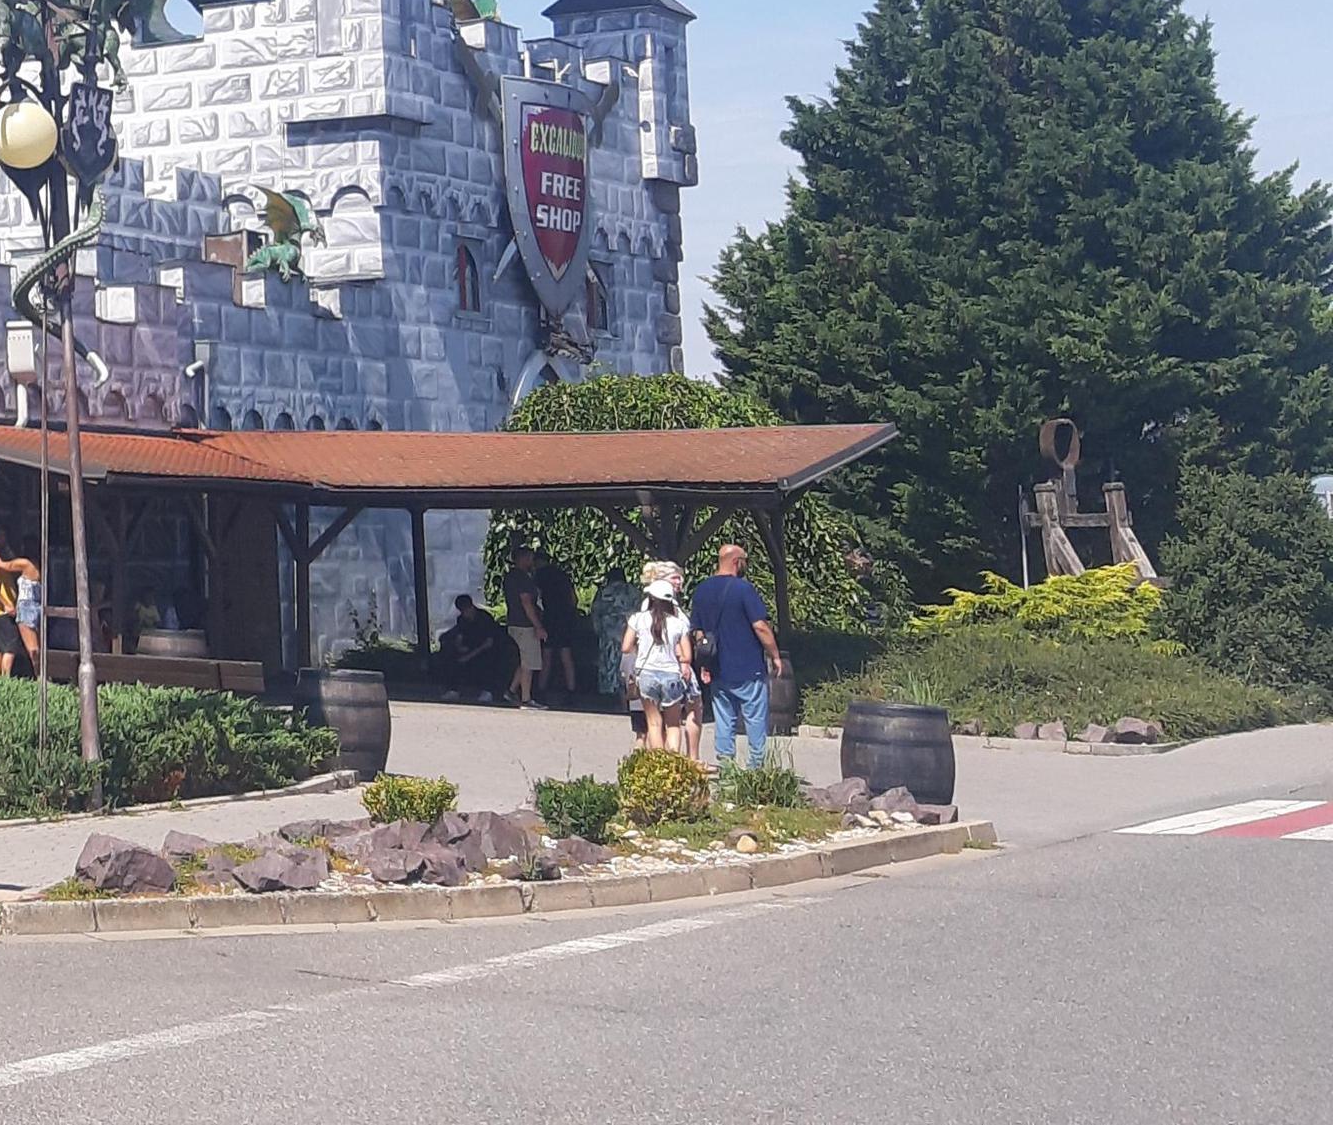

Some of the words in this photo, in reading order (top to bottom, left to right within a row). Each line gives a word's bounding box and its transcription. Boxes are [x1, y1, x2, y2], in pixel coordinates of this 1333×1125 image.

[530, 120, 584, 161] EXCALIB
[541, 171, 582, 201] FREE
[536, 204, 581, 233] SHOP
